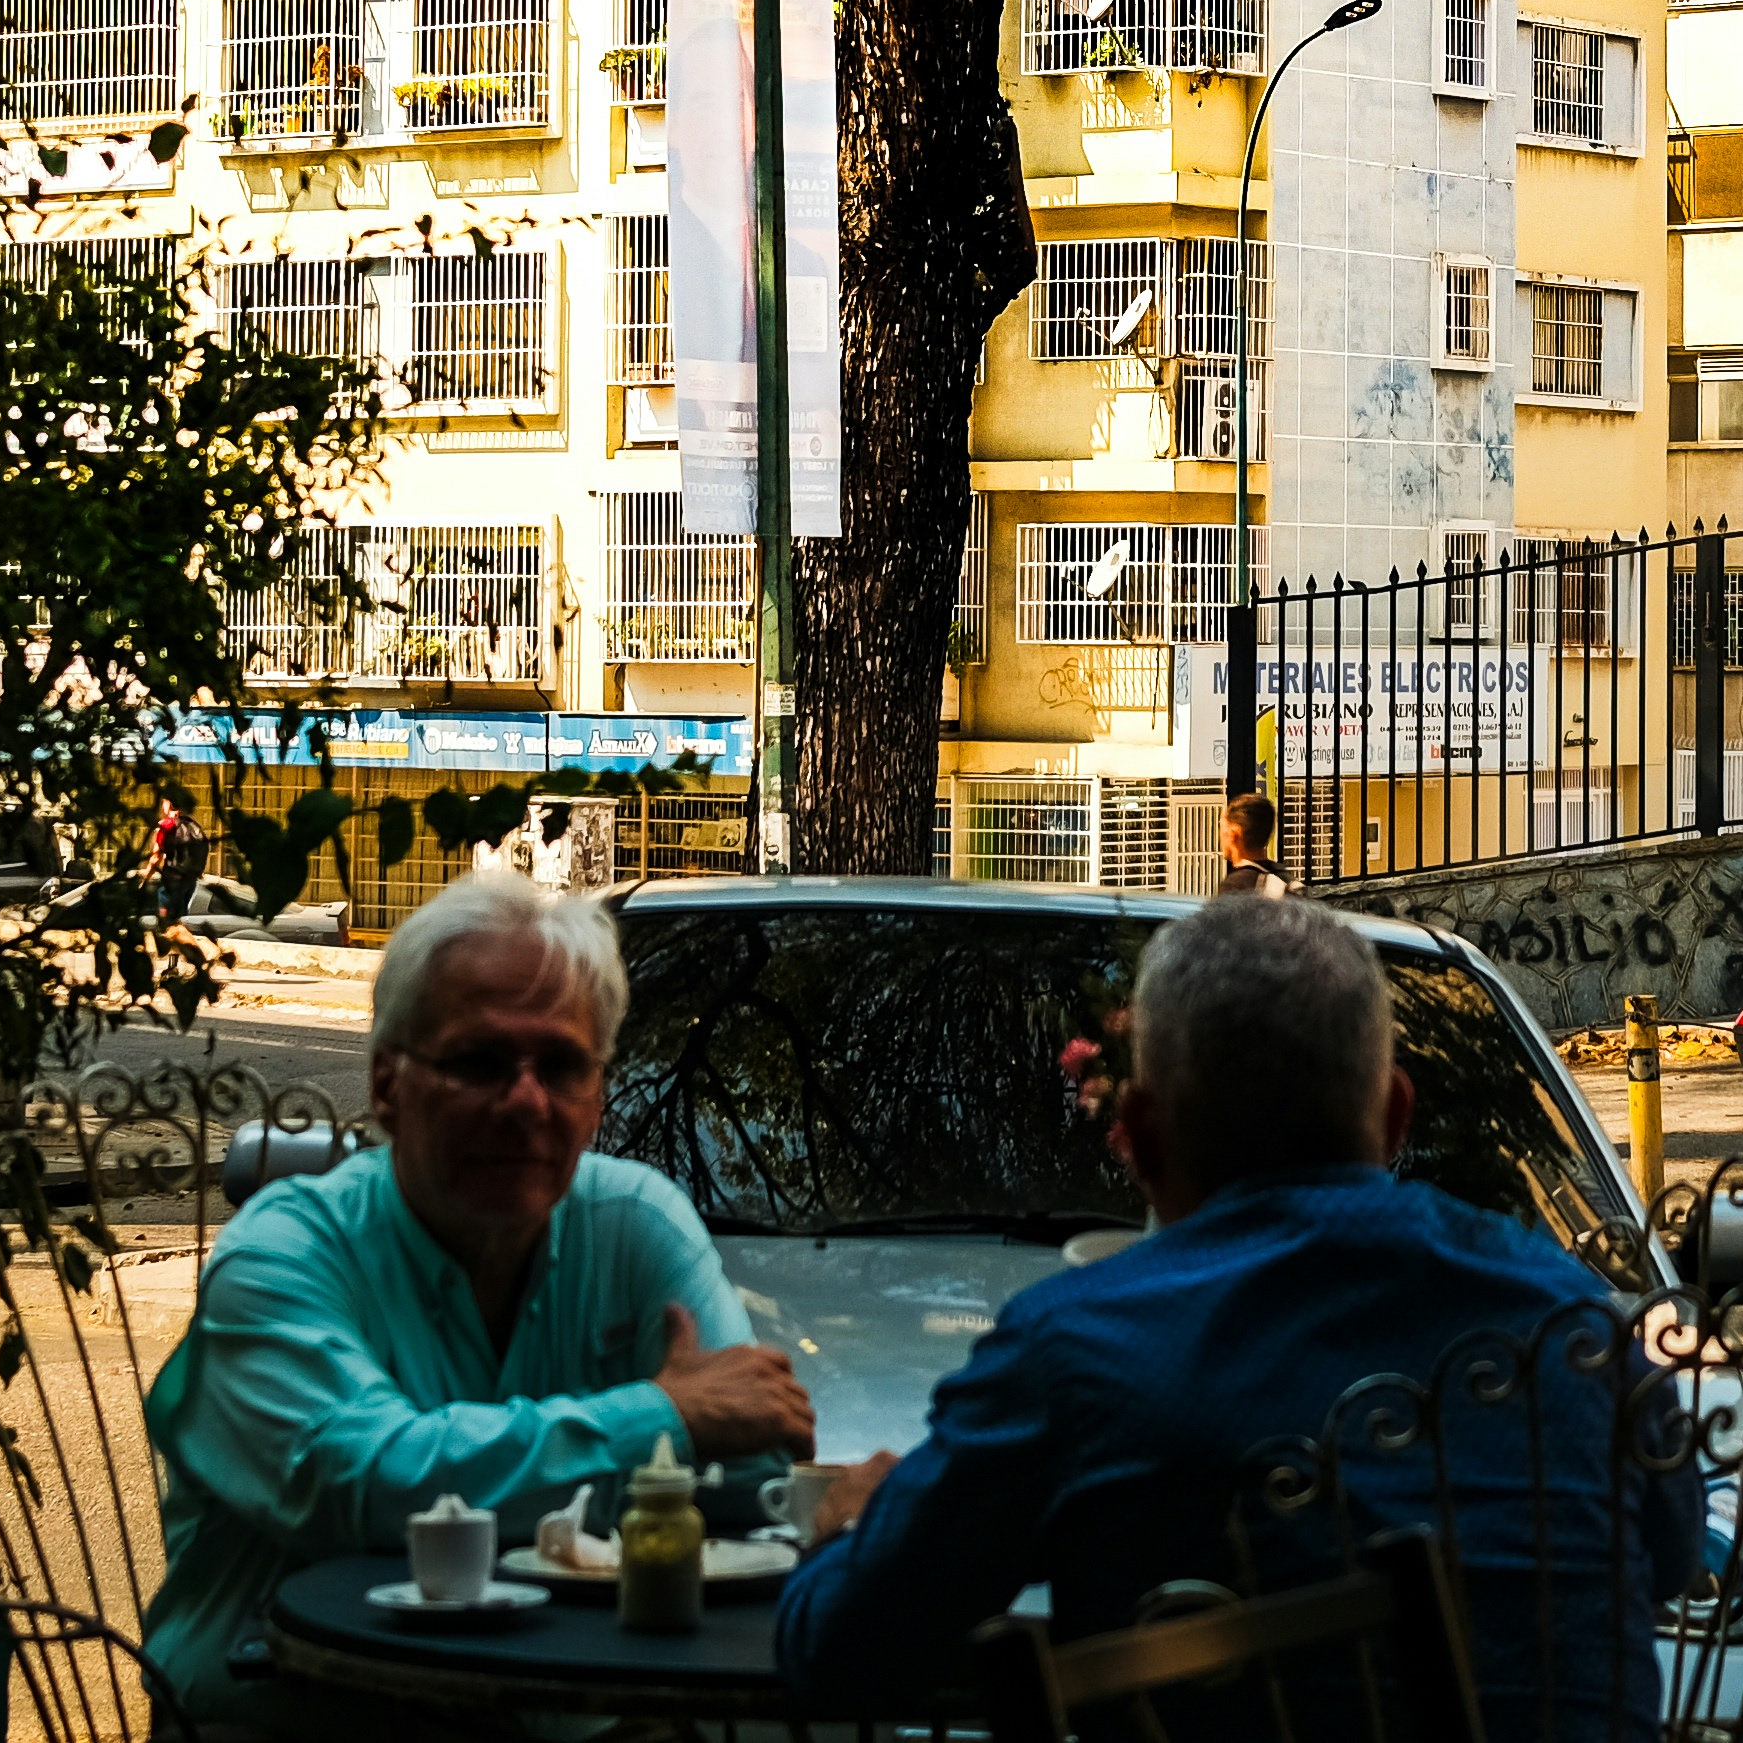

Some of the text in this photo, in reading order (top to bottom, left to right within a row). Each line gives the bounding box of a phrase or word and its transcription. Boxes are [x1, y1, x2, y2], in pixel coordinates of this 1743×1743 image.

[1213, 661, 1373, 695] MTERIALES
[1380, 661, 1529, 694] ELECRCOS
[1276, 724, 1319, 737] AYOR
